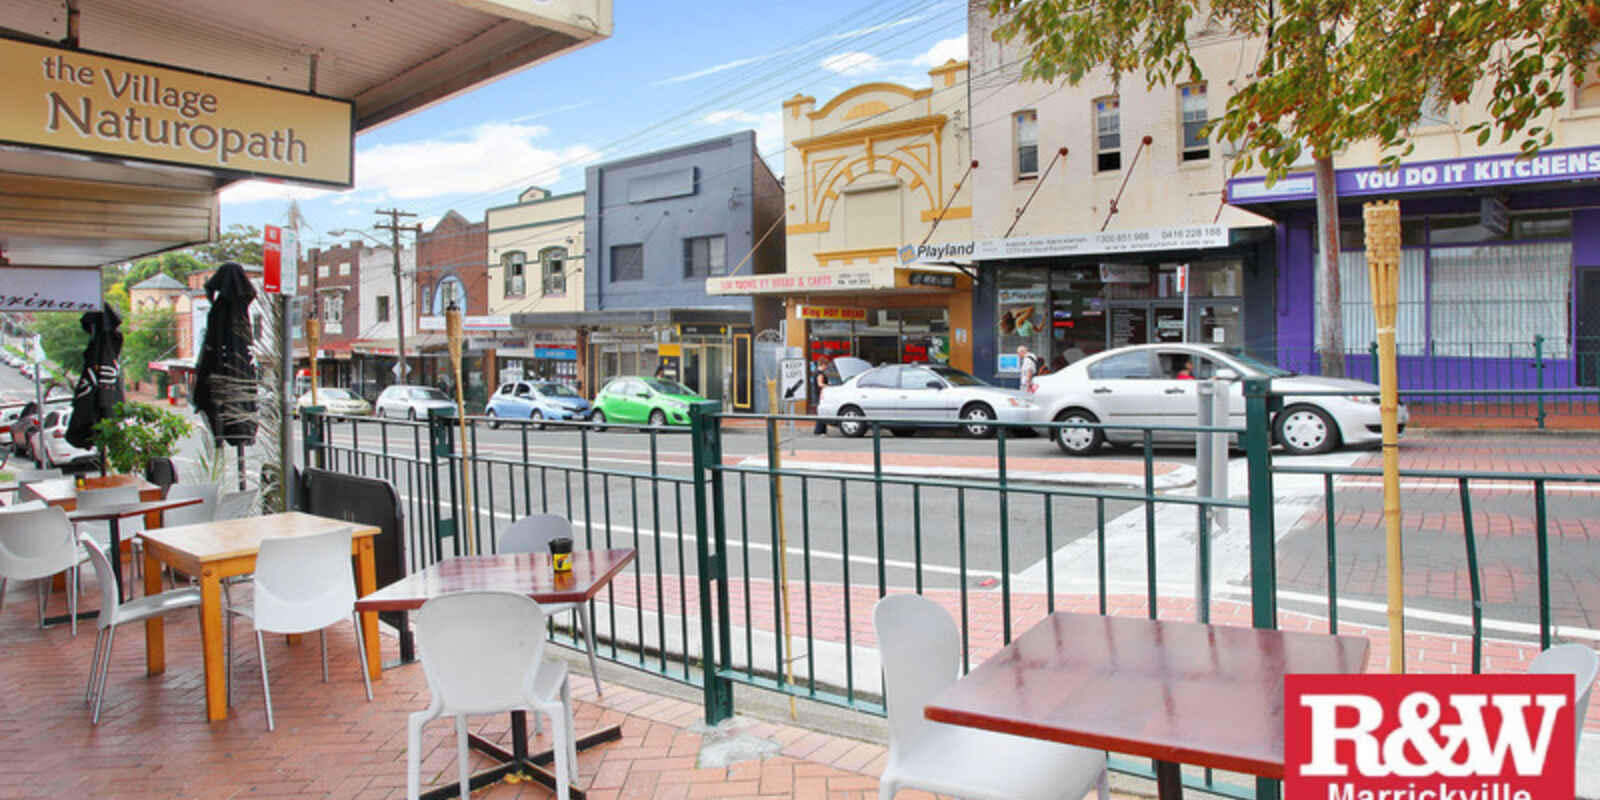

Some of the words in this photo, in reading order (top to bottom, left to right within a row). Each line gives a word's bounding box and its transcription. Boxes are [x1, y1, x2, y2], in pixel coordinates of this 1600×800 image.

[42, 56, 94, 84] the
[103, 67, 218, 118] Village
[47, 91, 308, 164] Naturopath
[1355, 170, 1399, 189] YOU
[1405, 166, 1437, 185] DO
[1443, 163, 1467, 182] IT
[917, 241, 975, 260] Playland
